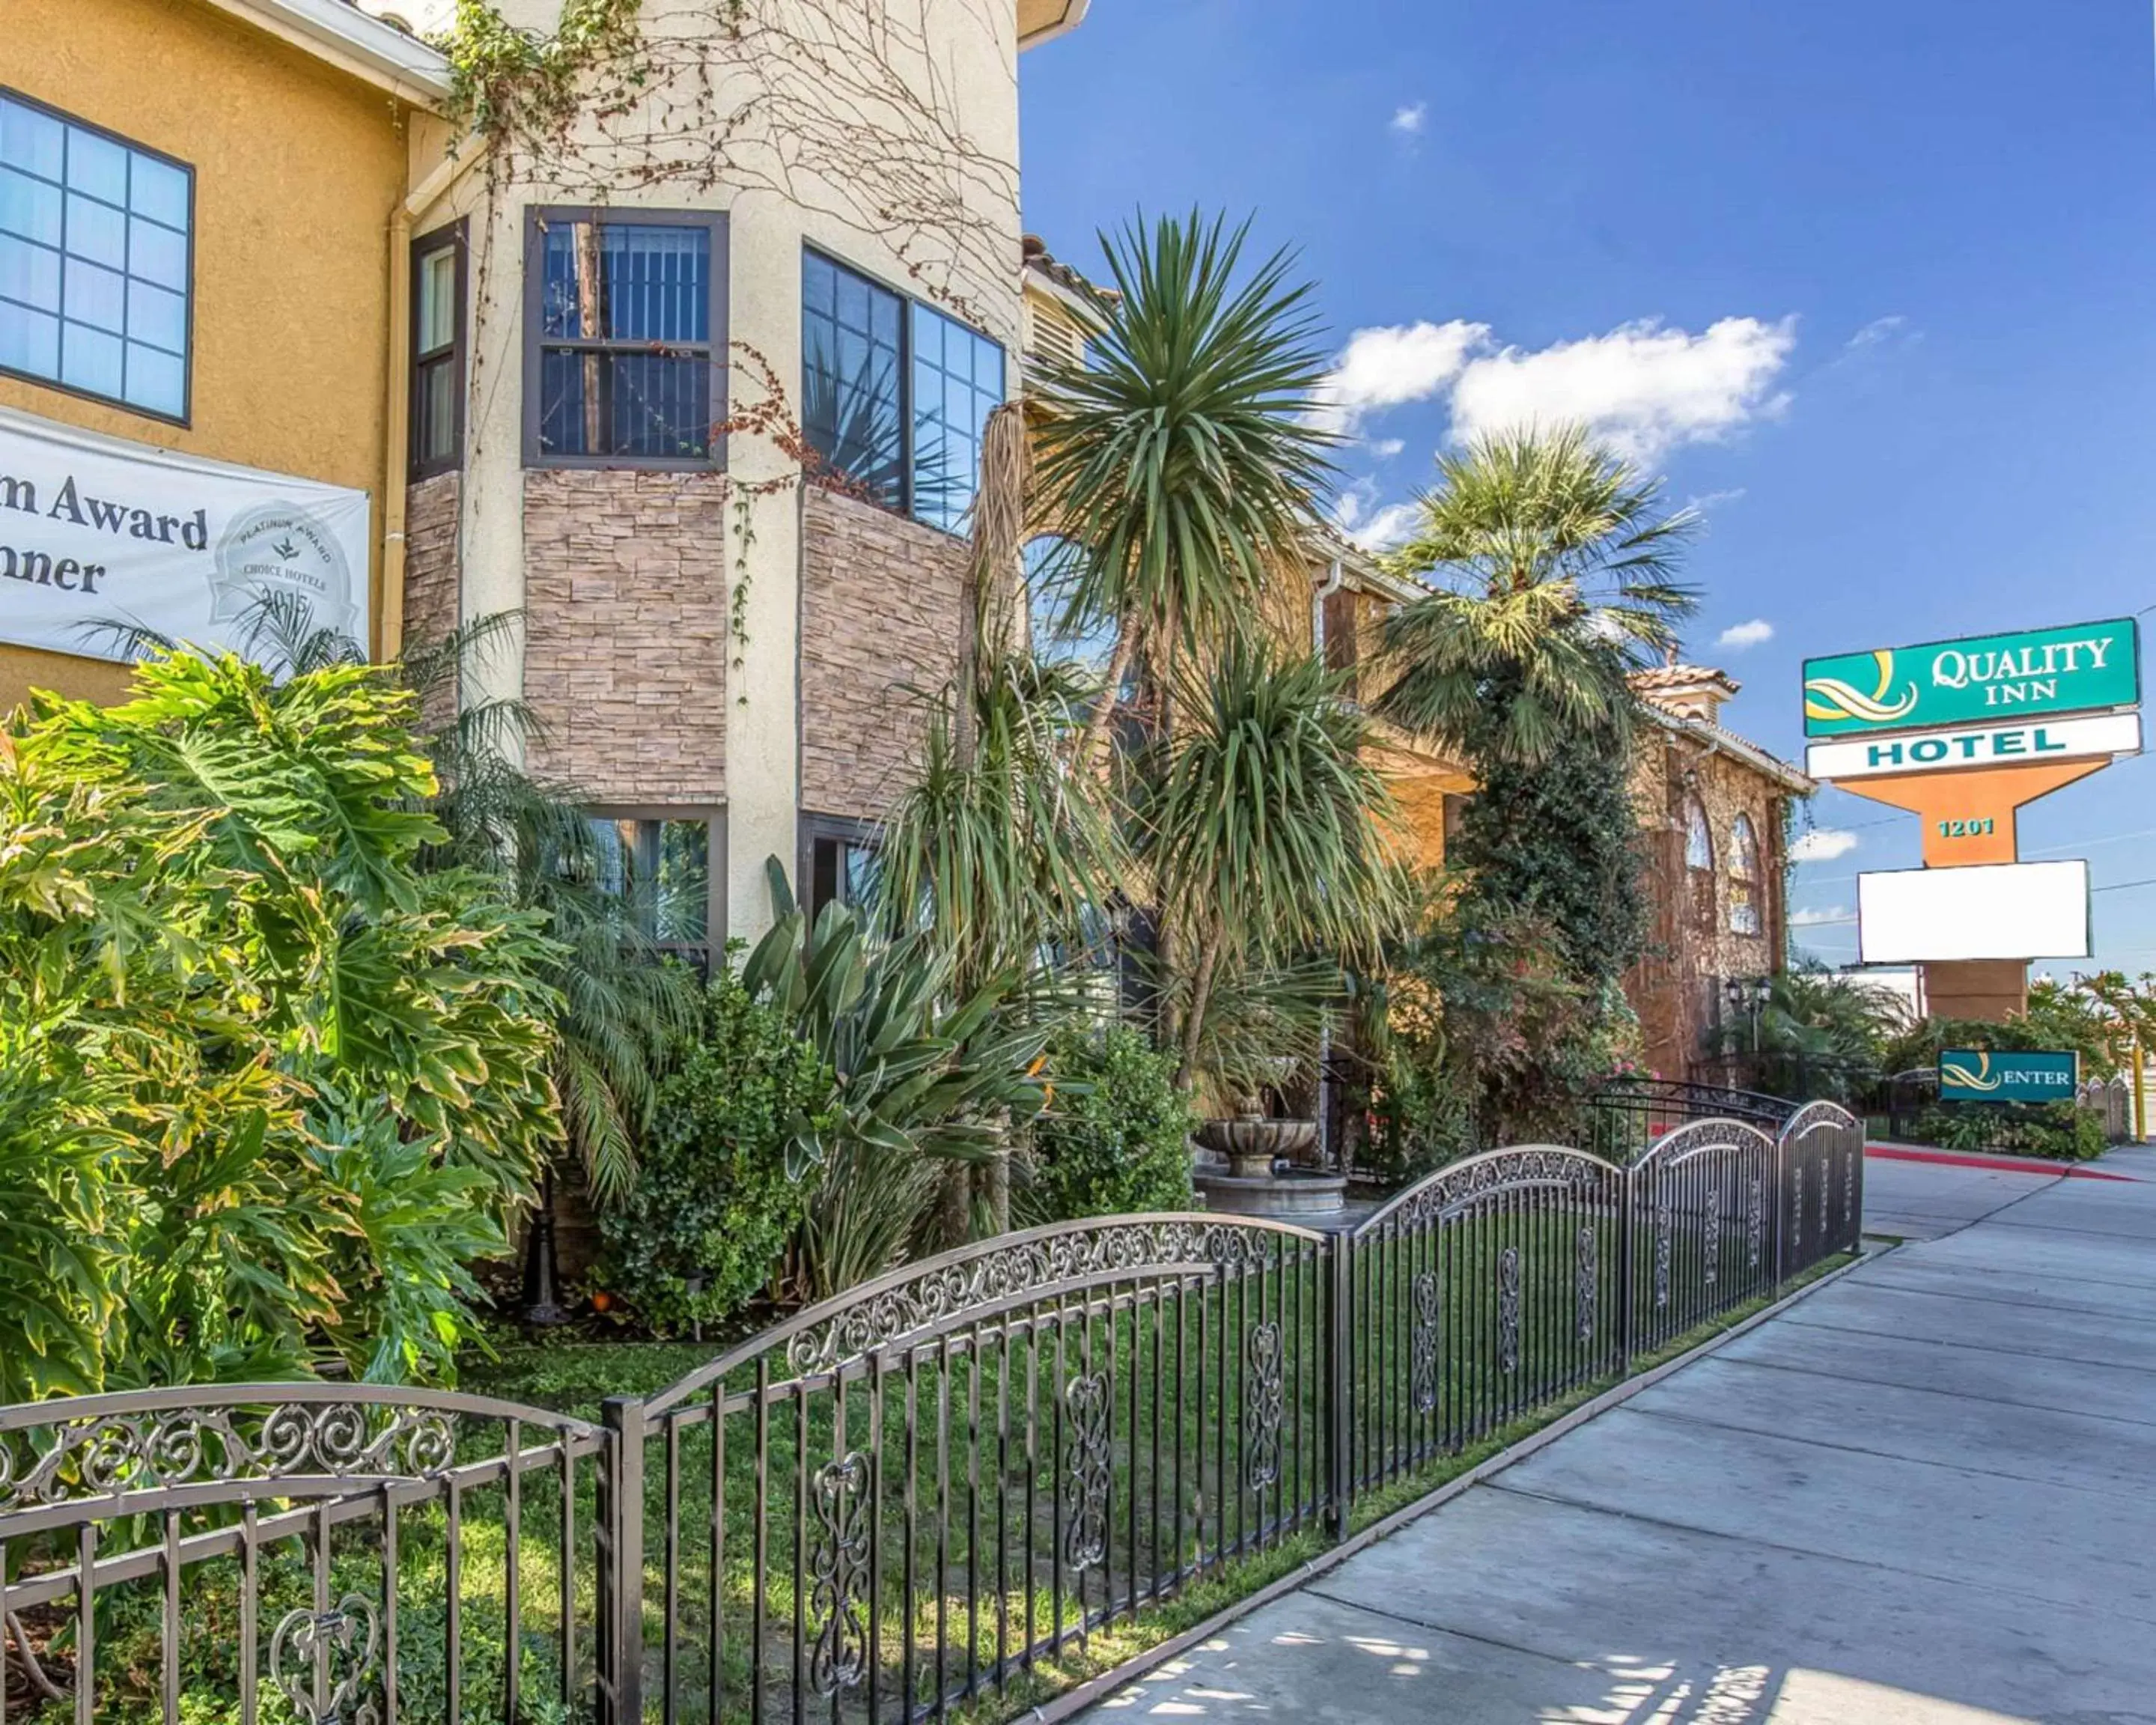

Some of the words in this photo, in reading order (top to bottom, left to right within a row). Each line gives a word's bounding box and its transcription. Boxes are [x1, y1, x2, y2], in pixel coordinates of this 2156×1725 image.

[46, 475, 208, 552] Award
[240, 518, 293, 544] PLATINUM
[292, 525, 332, 565] AWARD
[243, 563, 283, 578] CHOICE
[284, 569, 326, 592] HOTELS
[1931, 637, 2113, 689] QUALITY
[1985, 678, 2058, 706] INN
[1867, 728, 2066, 767] HOTEL
[1938, 818, 1994, 839] 1201
[2003, 1069, 2070, 1086] ENTER
